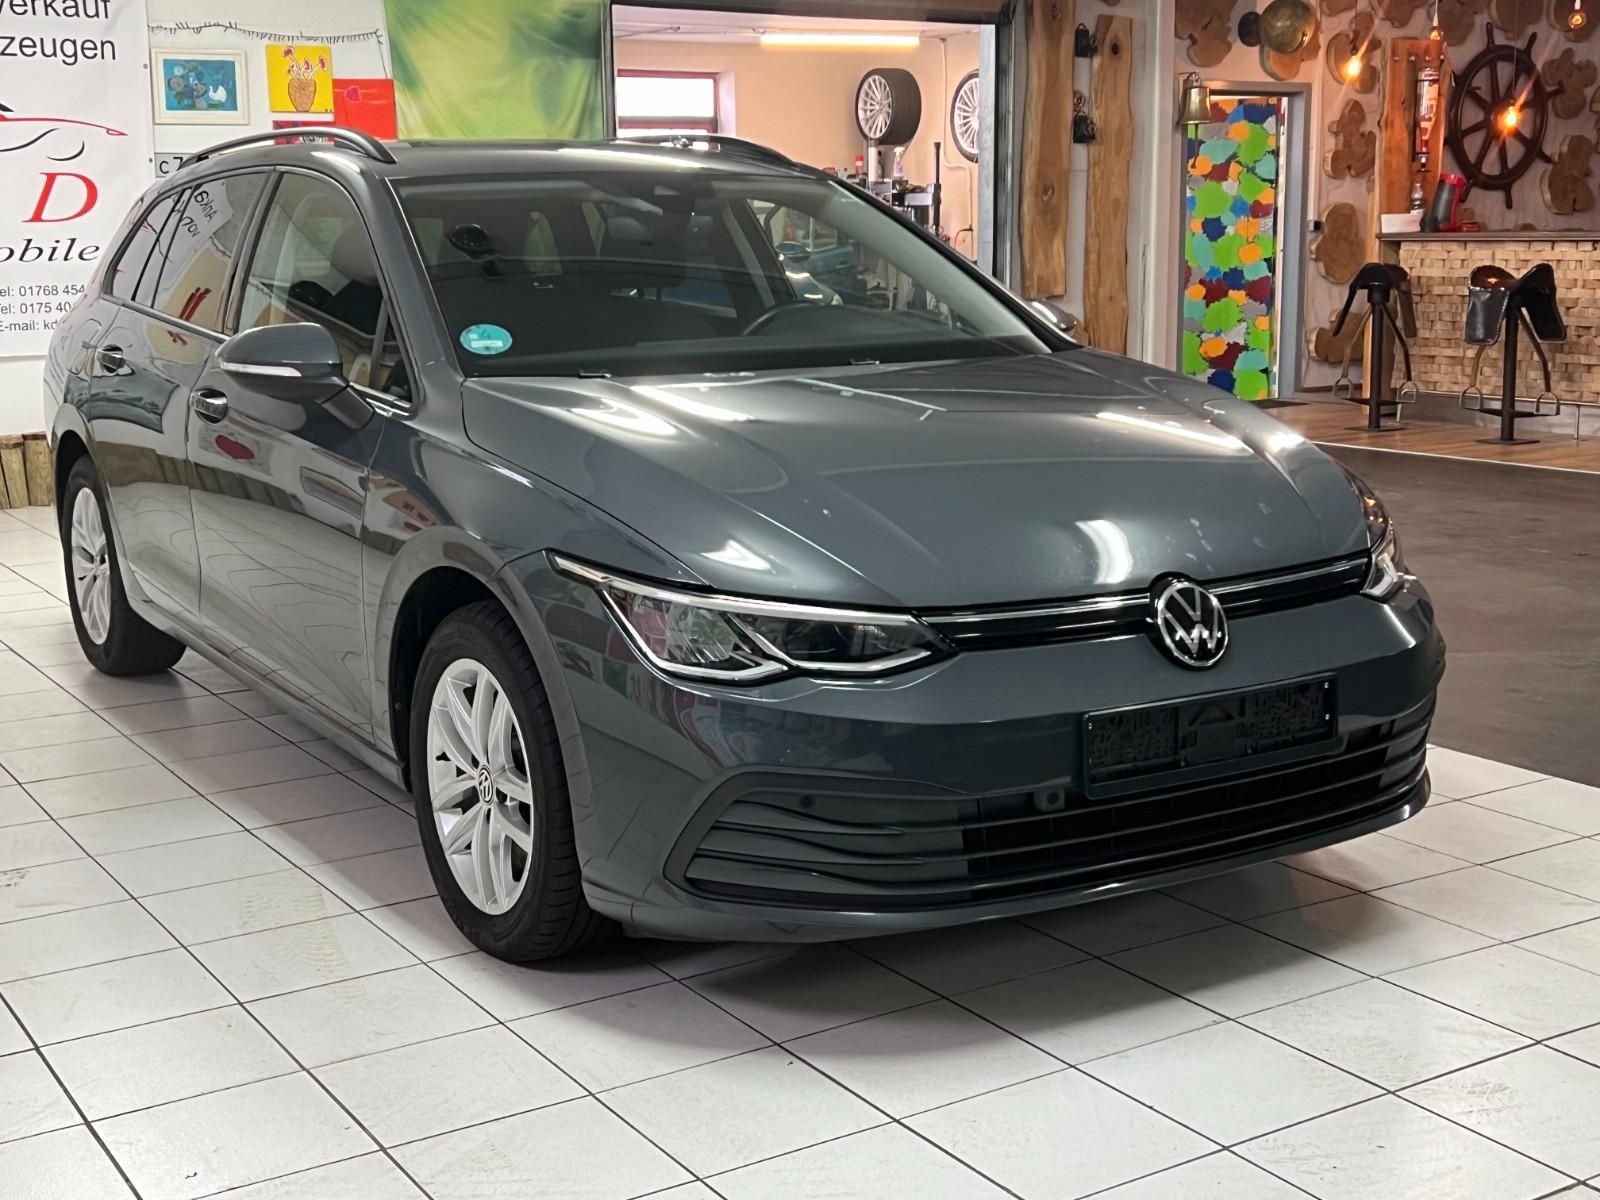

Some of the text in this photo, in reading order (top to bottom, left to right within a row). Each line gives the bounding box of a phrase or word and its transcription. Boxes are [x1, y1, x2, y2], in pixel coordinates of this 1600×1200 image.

[0, 0, 110, 19] erkauf
[21, 172, 98, 223] D
[19, 285, 59, 297] 01768
[20, 302, 52, 314] 0175
